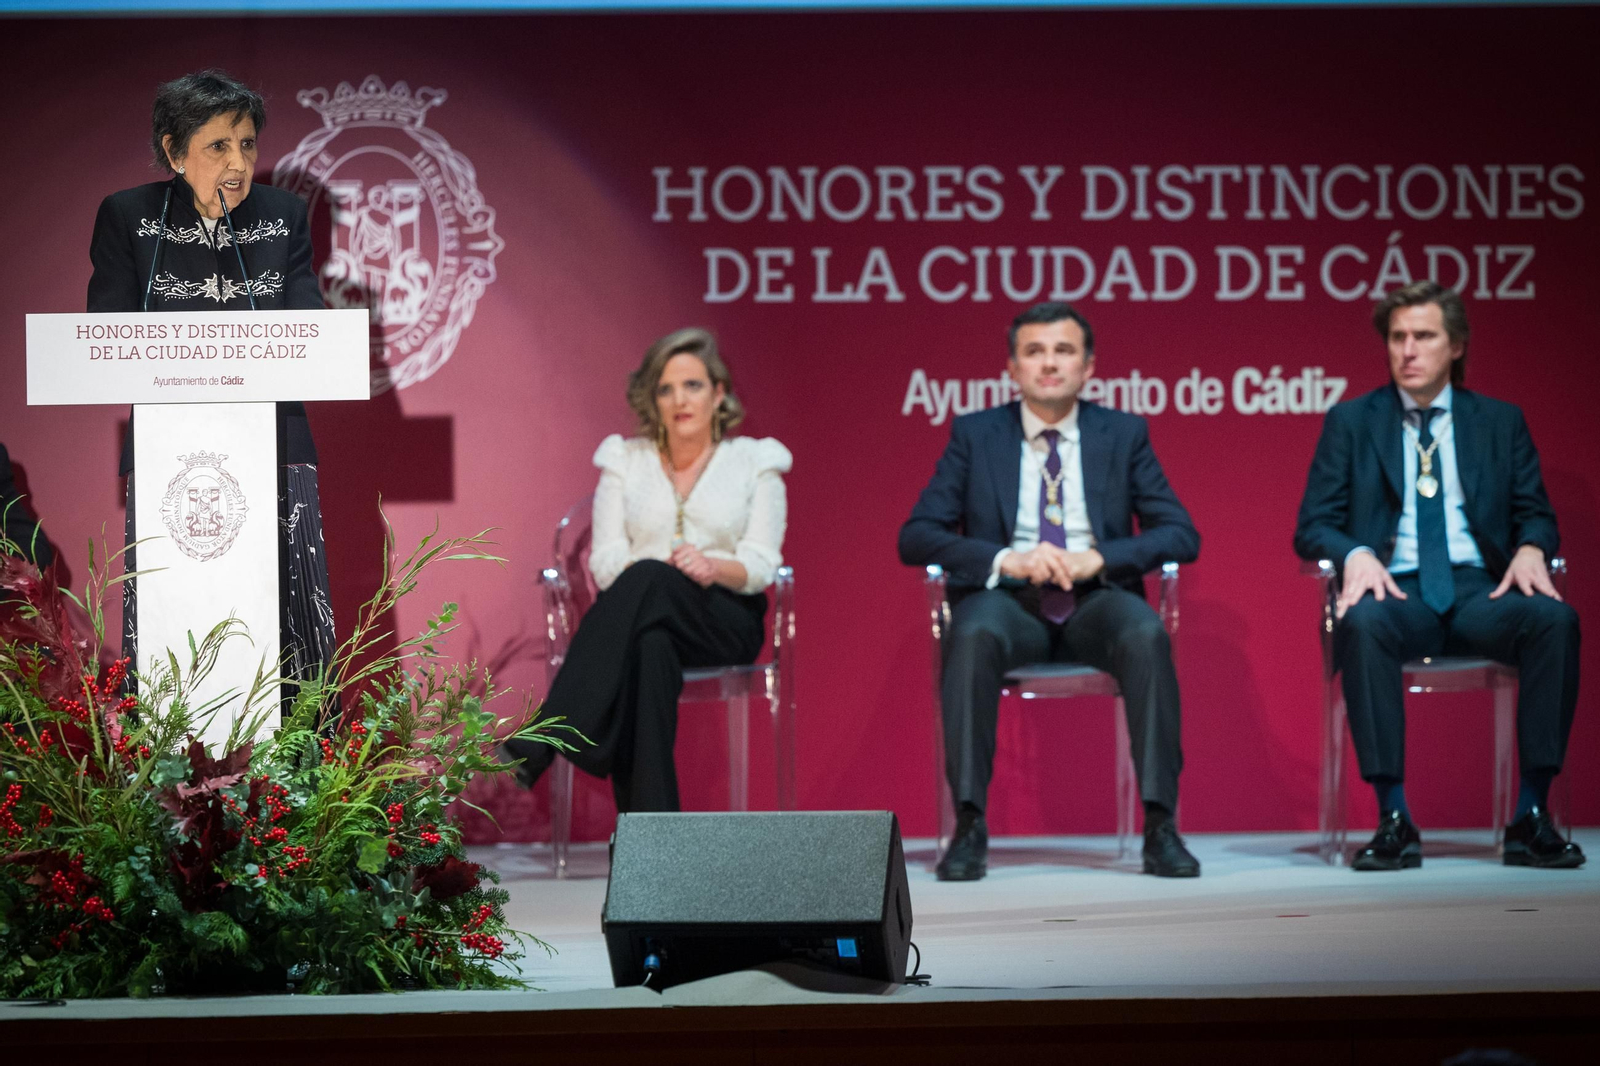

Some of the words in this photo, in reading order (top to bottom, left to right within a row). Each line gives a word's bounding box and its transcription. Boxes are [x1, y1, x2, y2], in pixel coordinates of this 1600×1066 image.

[652, 165, 1005, 222] HONORES
[1018, 165, 1065, 221] Y
[1081, 164, 1585, 222] DISTINCIONES
[703, 246, 795, 303] DE
[812, 246, 906, 303] LA
[919, 245, 1198, 303] CIUDAD
[1215, 245, 1306, 302] DE
[1320, 229, 1536, 302] CÁDIZ
[76, 324, 168, 339] HONORES
[171, 324, 183, 338] Y
[187, 323, 320, 338] DISTINCIONES
[89, 345, 113, 360] DE
[117, 345, 141, 360] LA
[145, 345, 218, 360] CIUDAD
[222, 345, 246, 359] DE
[250, 341, 307, 359] CÁDIZ
[153, 376, 208, 388] Ayuntamiento
[208, 376, 219, 386] de
[220, 375, 245, 386] Cádiz
[902, 367, 1166, 427] Ayuntento
[1175, 366, 1224, 416] de
[1232, 364, 1349, 416] Cádiz
